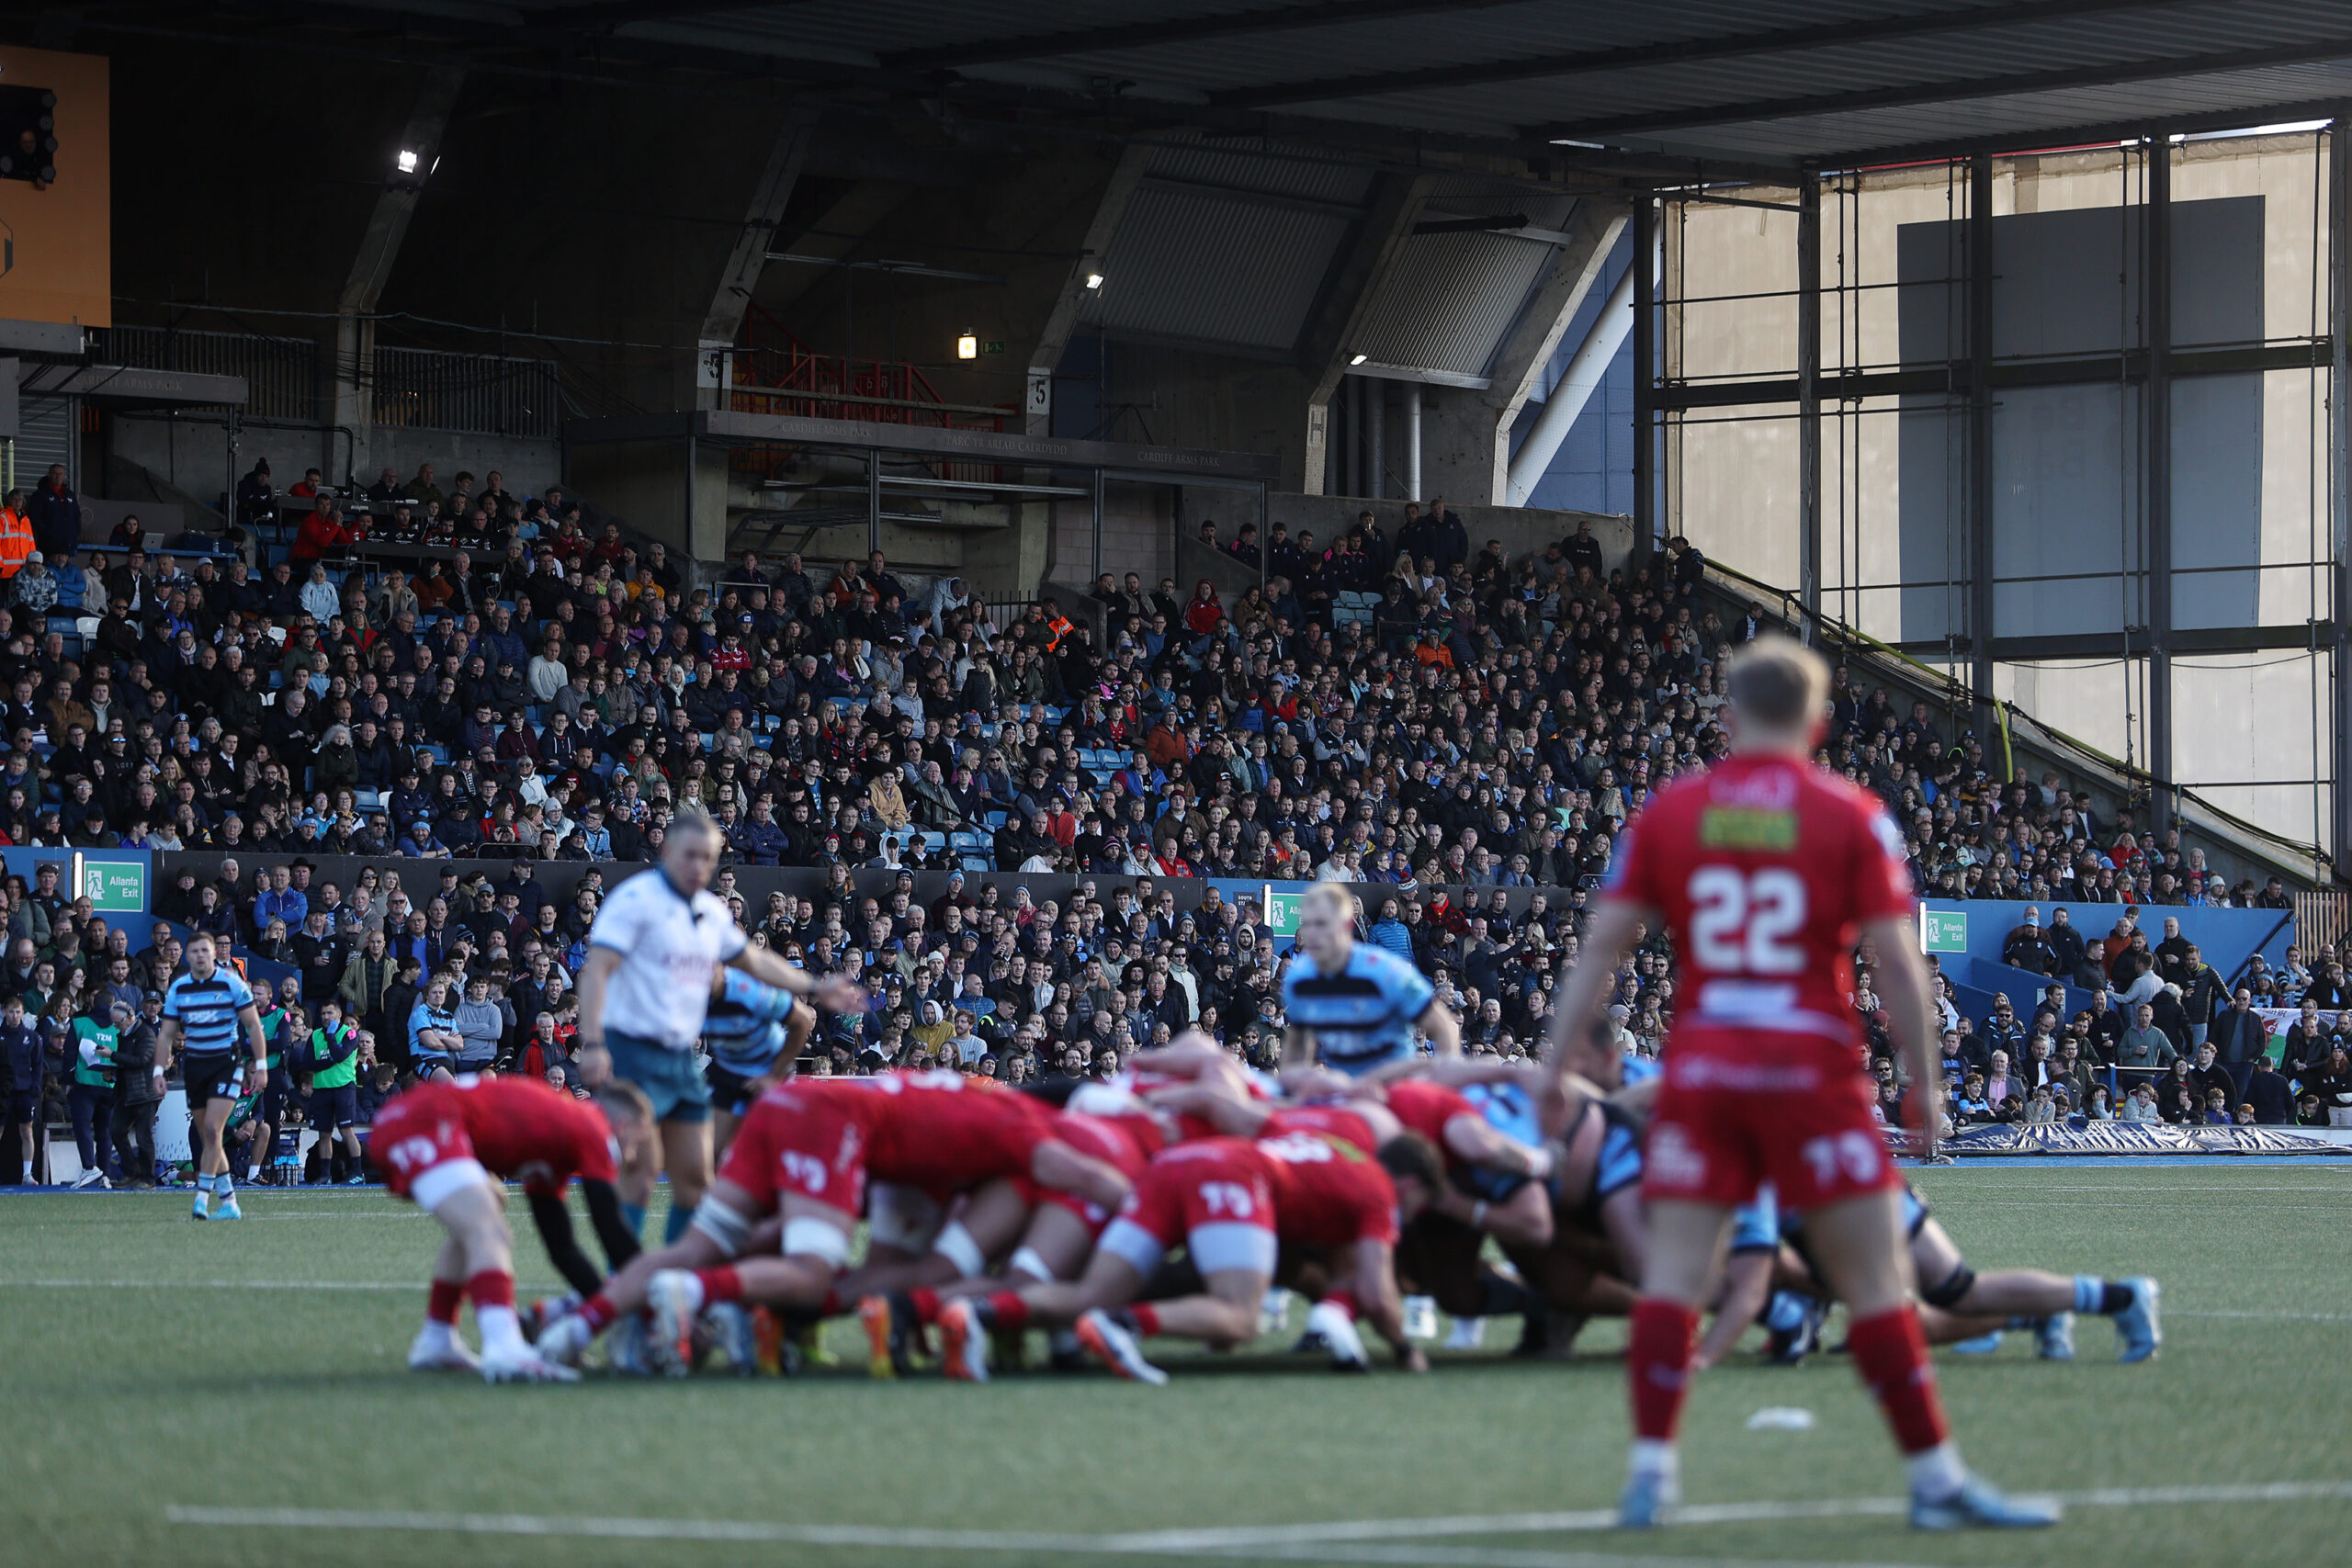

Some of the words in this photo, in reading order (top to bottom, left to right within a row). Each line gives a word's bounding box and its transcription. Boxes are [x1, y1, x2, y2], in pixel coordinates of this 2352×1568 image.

[124, 378, 153, 389] ARMS
[156, 379, 183, 391] PARK
[1035, 379, 1046, 404] 5
[781, 422, 820, 434] CARDIFF
[822, 425, 847, 436] ARMS
[849, 427, 872, 439] PARK
[946, 435, 971, 447] PARC
[972, 436, 985, 448] YR
[1017, 440, 1068, 456] CAERDYDD
[1137, 450, 1174, 464] CARDIFF
[1175, 454, 1198, 464] ARMS
[1199, 455, 1221, 468] PARK
[109, 875, 139, 886] Allanfa
[121, 887, 139, 897] Exit
[1687, 863, 1808, 976] 22
[1943, 923, 1963, 931] Allanfa
[96, 1032, 112, 1043] TZM
